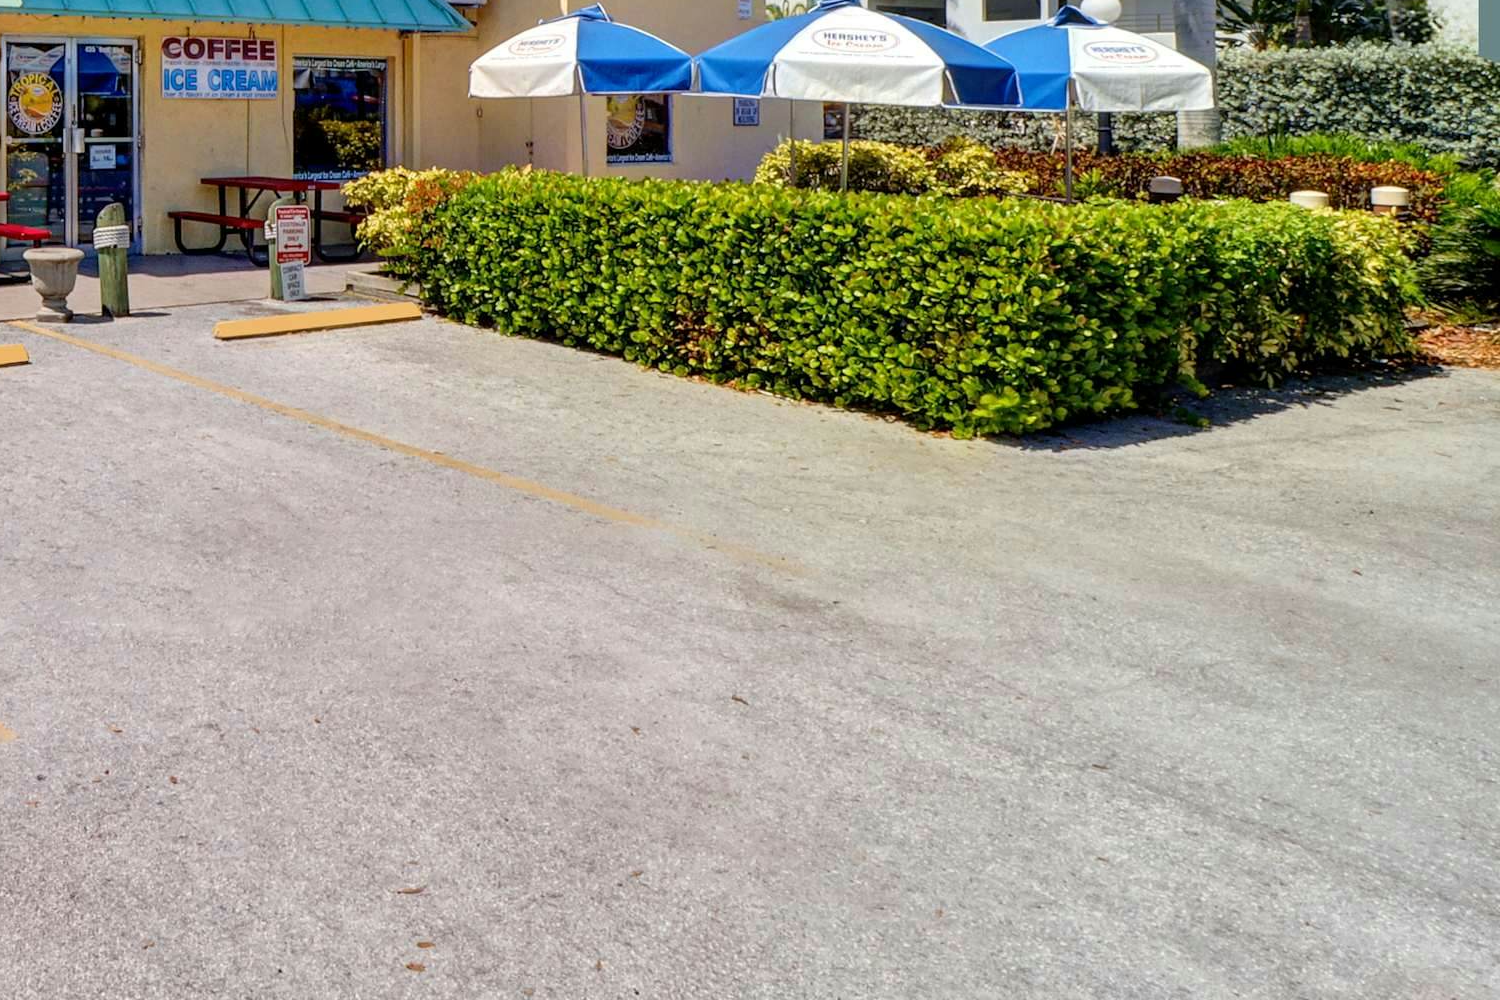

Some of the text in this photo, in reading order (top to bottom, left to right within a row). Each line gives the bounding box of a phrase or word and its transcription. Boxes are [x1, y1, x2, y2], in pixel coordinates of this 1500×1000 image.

[162, 37, 275, 60] COFFEE
[823, 32, 888, 42] HERSHEY'S
[11, 73, 59, 97] TROPICAL
[163, 69, 278, 92] ICE CREAM
[13, 110, 37, 132] CREAM
[41, 101, 62, 132] COFFEE
